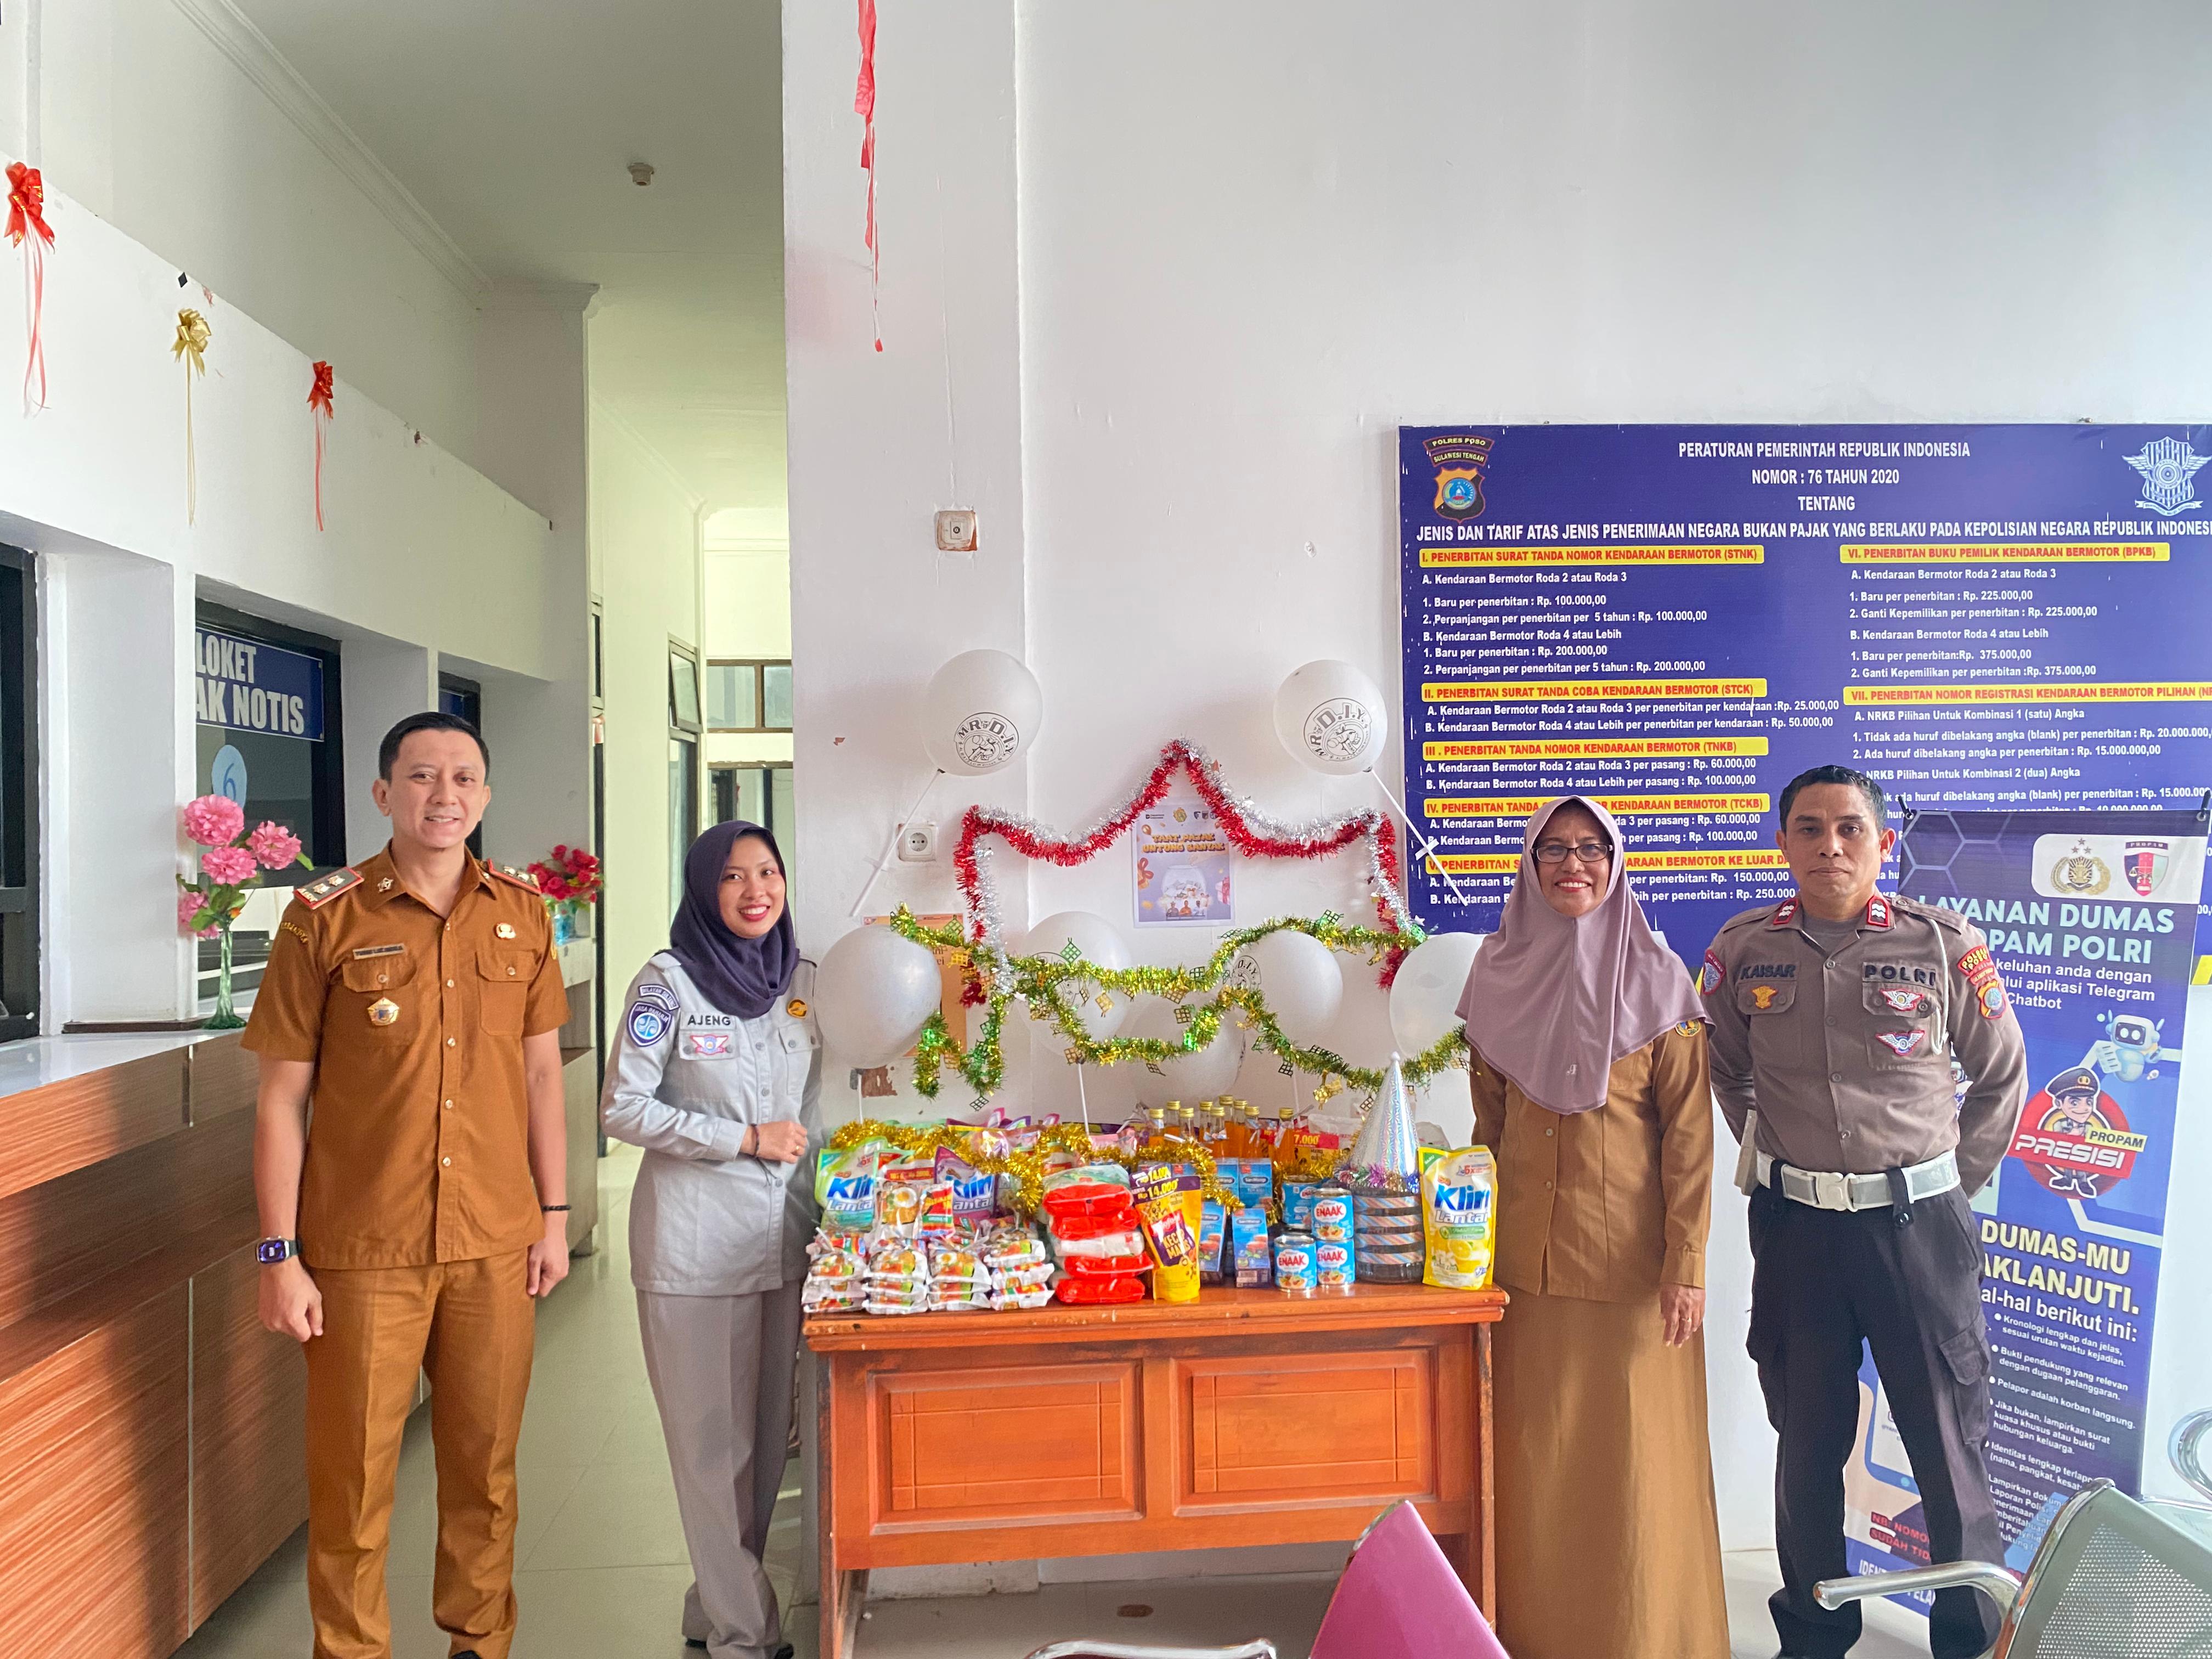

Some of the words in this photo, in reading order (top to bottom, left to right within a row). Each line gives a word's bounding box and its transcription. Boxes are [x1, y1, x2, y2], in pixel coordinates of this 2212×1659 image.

[1432, 438, 1462, 447] POLRES
[1679, 443, 1753, 457] PERATURAN
[1756, 443, 1836, 457] PEMERINTAH
[1839, 443, 1900, 457] REPUBLIK
[1903, 442, 1970, 456] INDONESIA
[1434, 452, 1462, 462] SULAWESI
[1463, 452, 1485, 462] TENGAH
[1752, 469, 1797, 484] NOMOR
[1807, 469, 1822, 484] 76
[1825, 469, 1867, 484] TAHUN
[1871, 469, 1899, 484] 2020
[1797, 496, 1855, 511] TENTANG
[1416, 526, 1453, 541] JENIS
[1457, 526, 1483, 540] DAN
[1486, 525, 1523, 540] TARIF
[1526, 524, 1559, 539] ATAS
[1561, 524, 1599, 539] JENIS
[1602, 523, 1684, 538] PENERIMAAN
[1688, 523, 1740, 538] NEGARA
[1743, 523, 1786, 538] BUKAN
[1790, 523, 1830, 537] PAJAK
[1832, 522, 1866, 537] YANG
[1869, 522, 1926, 537] BERLAKU
[1929, 522, 1961, 537] PADA
[1964, 522, 2036, 537] KEPOLISIAN
[2040, 521, 2091, 536] NEGARA
[2093, 521, 2154, 535] REPUBLIK
[1422, 552, 1428, 562] I.
[1431, 552, 1493, 562] PENERBITAN
[1496, 551, 1528, 561] SURAT
[1531, 551, 1564, 561] TANDA
[1566, 550, 1602, 560] NOMOR
[1605, 550, 1665, 560] KENDARAAN
[1667, 549, 1722, 559] BERMOTOR
[1724, 549, 1757, 560] (STNK)
[1848, 549, 1861, 558] VI.
[1864, 548, 1926, 558] PENERBITAN
[1928, 548, 1956, 557] BUKU
[1959, 548, 1999, 557] PEMILIK
[2002, 548, 2063, 557] KENDARAAN
[2065, 547, 2119, 557] BERMOTOR
[2123, 546, 2155, 558] (BPKB)
[1421, 574, 1432, 584] A.
[1435, 574, 1486, 584] Kendaraan
[1488, 573, 1534, 583] Bermotor
[1536, 573, 1560, 583] Roda
[1562, 572, 1568, 582] 2
[1571, 573, 1592, 582] atau
[1594, 572, 1618, 582] Roda
[1621, 572, 1627, 582] 3
[1423, 597, 1431, 607] 1.
[1434, 597, 1457, 607] Baru
[1459, 599, 1475, 609] per
[1477, 596, 1528, 608] penerbitan
[1537, 596, 1551, 608] Rp.
[1554, 595, 1606, 606] 100.000,00
[1849, 608, 1858, 618] 2.
[1860, 608, 1887, 618] Ganti
[1889, 608, 1948, 619] Kepemilikan
[1950, 610, 1966, 619] per
[1968, 607, 2019, 619] penerbitan
[2028, 607, 2043, 619] Rp.
[2045, 606, 2097, 617] 225.000,00
[1851, 691, 1868, 701] VII.
[1870, 690, 1933, 701] PENERBITAN
[1935, 690, 1972, 699] NOMOR
[1974, 689, 2033, 698] REGISTRASI
[2036, 689, 2097, 698] KENDARAAN
[2099, 687, 2154, 697] BERMOTOR
[2156, 687, 2196, 697] PILIHAN
[233, 684, 304, 735] NOTIS
[1152, 834, 1180, 843] TAAT
[2059, 904, 2175, 933] DUMAS
[2063, 934, 2152, 964] POLRI
[1740, 964, 1797, 980] KAISAR
[1865, 964, 1936, 986] POLRI
[1996, 958, 2051, 975] keluhan
[2055, 965, 2091, 978] anda
[2096, 967, 2152, 985] dengan
[2026, 979, 2082, 995] aplikasi
[2086, 983, 2155, 1002] Telegram
[2008, 992, 2062, 1009] Chatbot
[687, 1014, 731, 1026] AJENG
[2089, 1130, 2144, 1148] PROPAM
[2015, 1134, 2125, 1169] PRESISI
[1316, 1205, 1344, 1217] ENAAK
[1435, 1209, 1489, 1224] Lantai
[1981, 1219, 2130, 1274] DUMAS-MU
[1278, 1255, 1306, 1266] ENAAK
[1317, 1250, 1345, 1262] ENAAK
[2036, 1298, 2102, 1333] berikut
[2107, 1317, 2137, 1342] ini:
[2004, 1315, 2044, 1334] Kronologi
[2046, 1327, 2080, 1344] lengkap
[2081, 1336, 2097, 1348] dan
[2099, 1341, 2122, 1356] jelas,
[2002, 1327, 2029, 1339] sesuai
[2031, 1335, 2058, 1347] urutan
[2060, 1342, 2085, 1355] waktu
[2087, 1349, 2126, 1367] kejadian.
[2000, 1346, 2022, 1359] Bukti
[2024, 1355, 2071, 1375] pendukung
[2073, 1369, 2094, 1383] yang
[2096, 1374, 2129, 1391] relevan
[1999, 1358, 2030, 1373] dengan
[2032, 1367, 2063, 1383] dugaan
[2064, 1377, 2120, 1401] pelanggaran.
[1997, 1378, 2029, 1394] Pelapor
[2031, 1389, 2058, 1403] adalah
[2061, 1398, 2090, 1414] korban
[1870, 1528, 1908, 1551] SUDAH
[1894, 1522, 1928, 1542] NOMO
